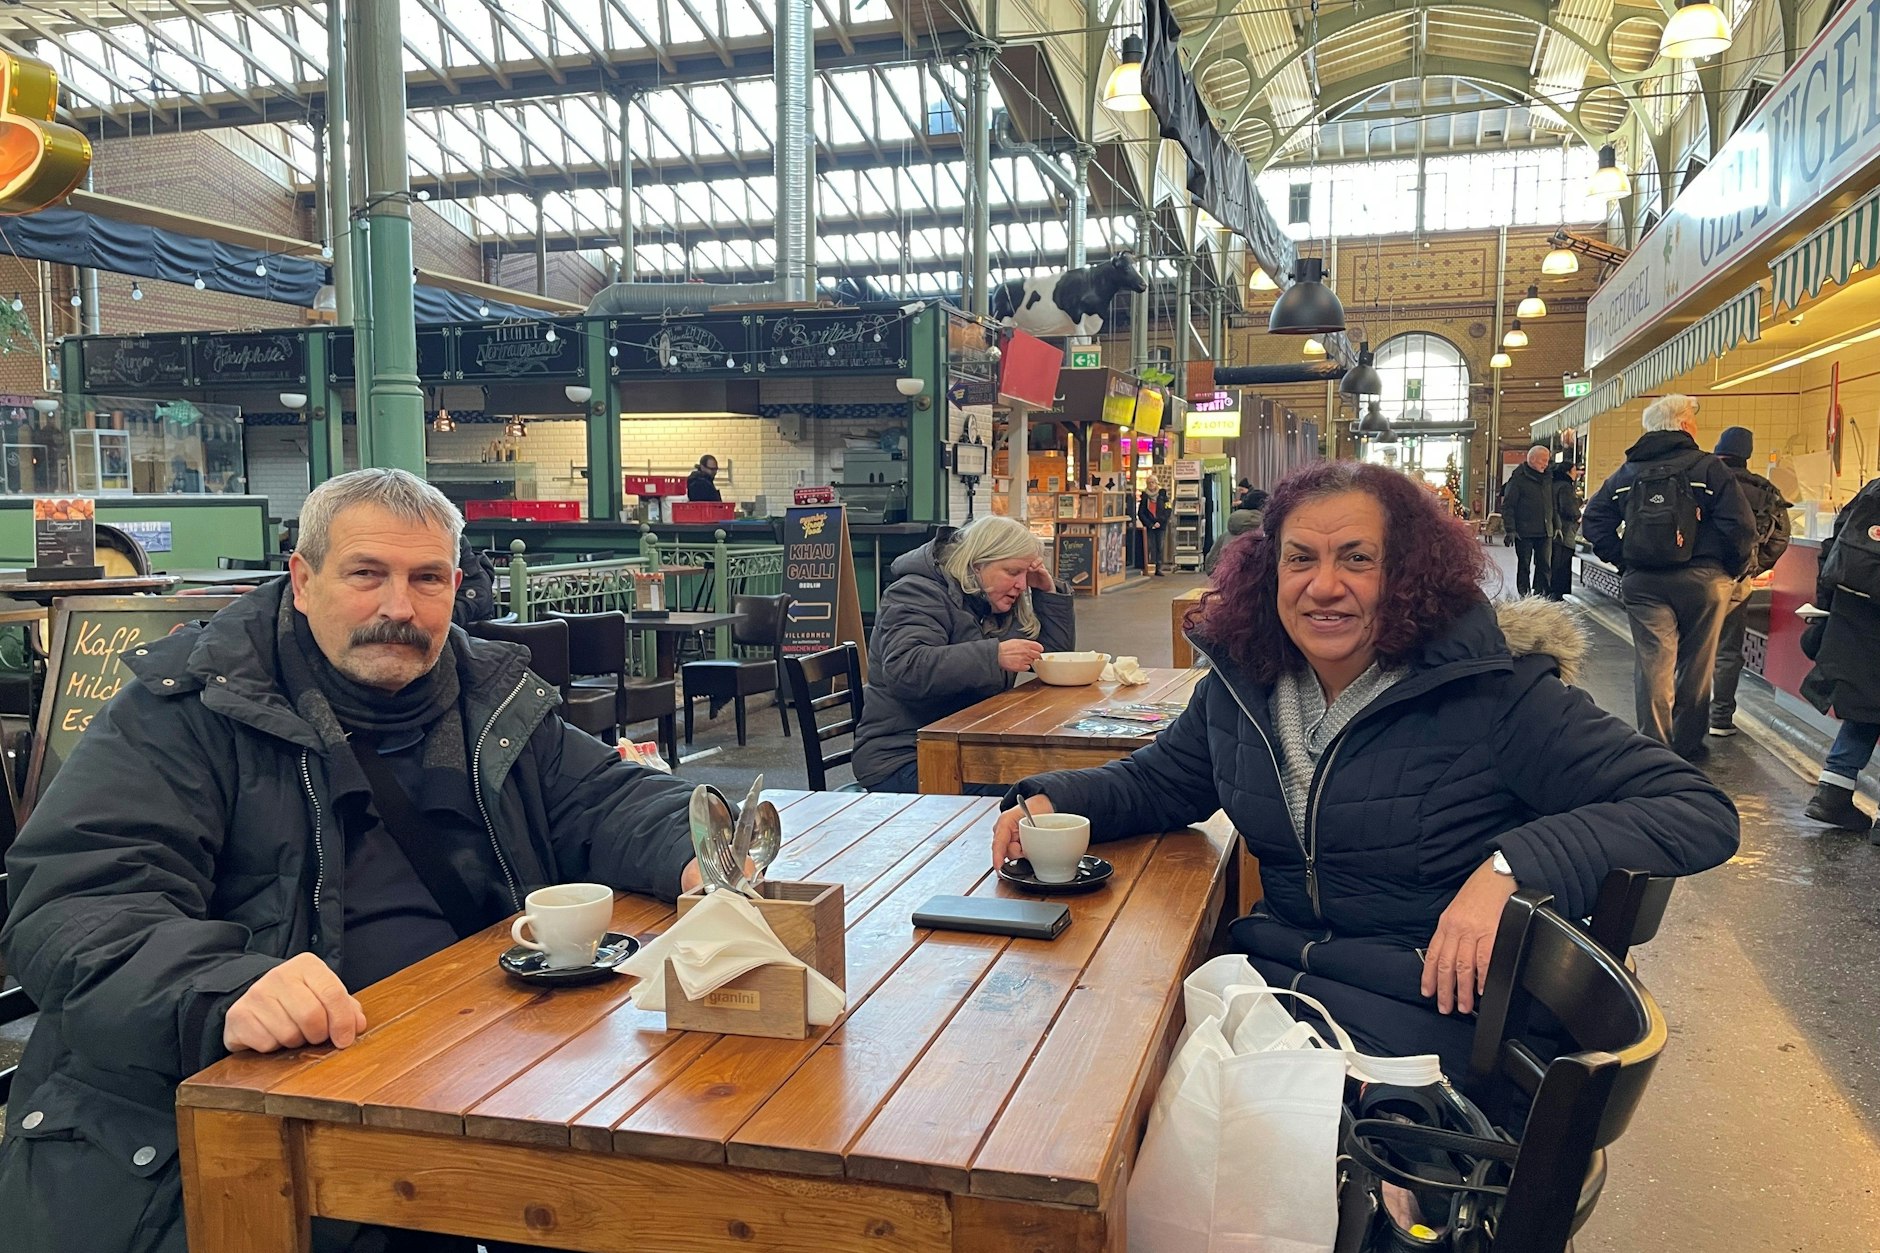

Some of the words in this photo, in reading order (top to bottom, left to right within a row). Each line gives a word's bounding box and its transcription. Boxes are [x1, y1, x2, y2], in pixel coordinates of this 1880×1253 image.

[1609, 265, 1651, 337] GEFLÜGEL
[1203, 420, 1234, 429] LOTTO
[789, 543, 836, 561] KHAU
[786, 563, 836, 580] GALLI
[73, 620, 146, 675] Kaff
[709, 992, 755, 1005] granini
